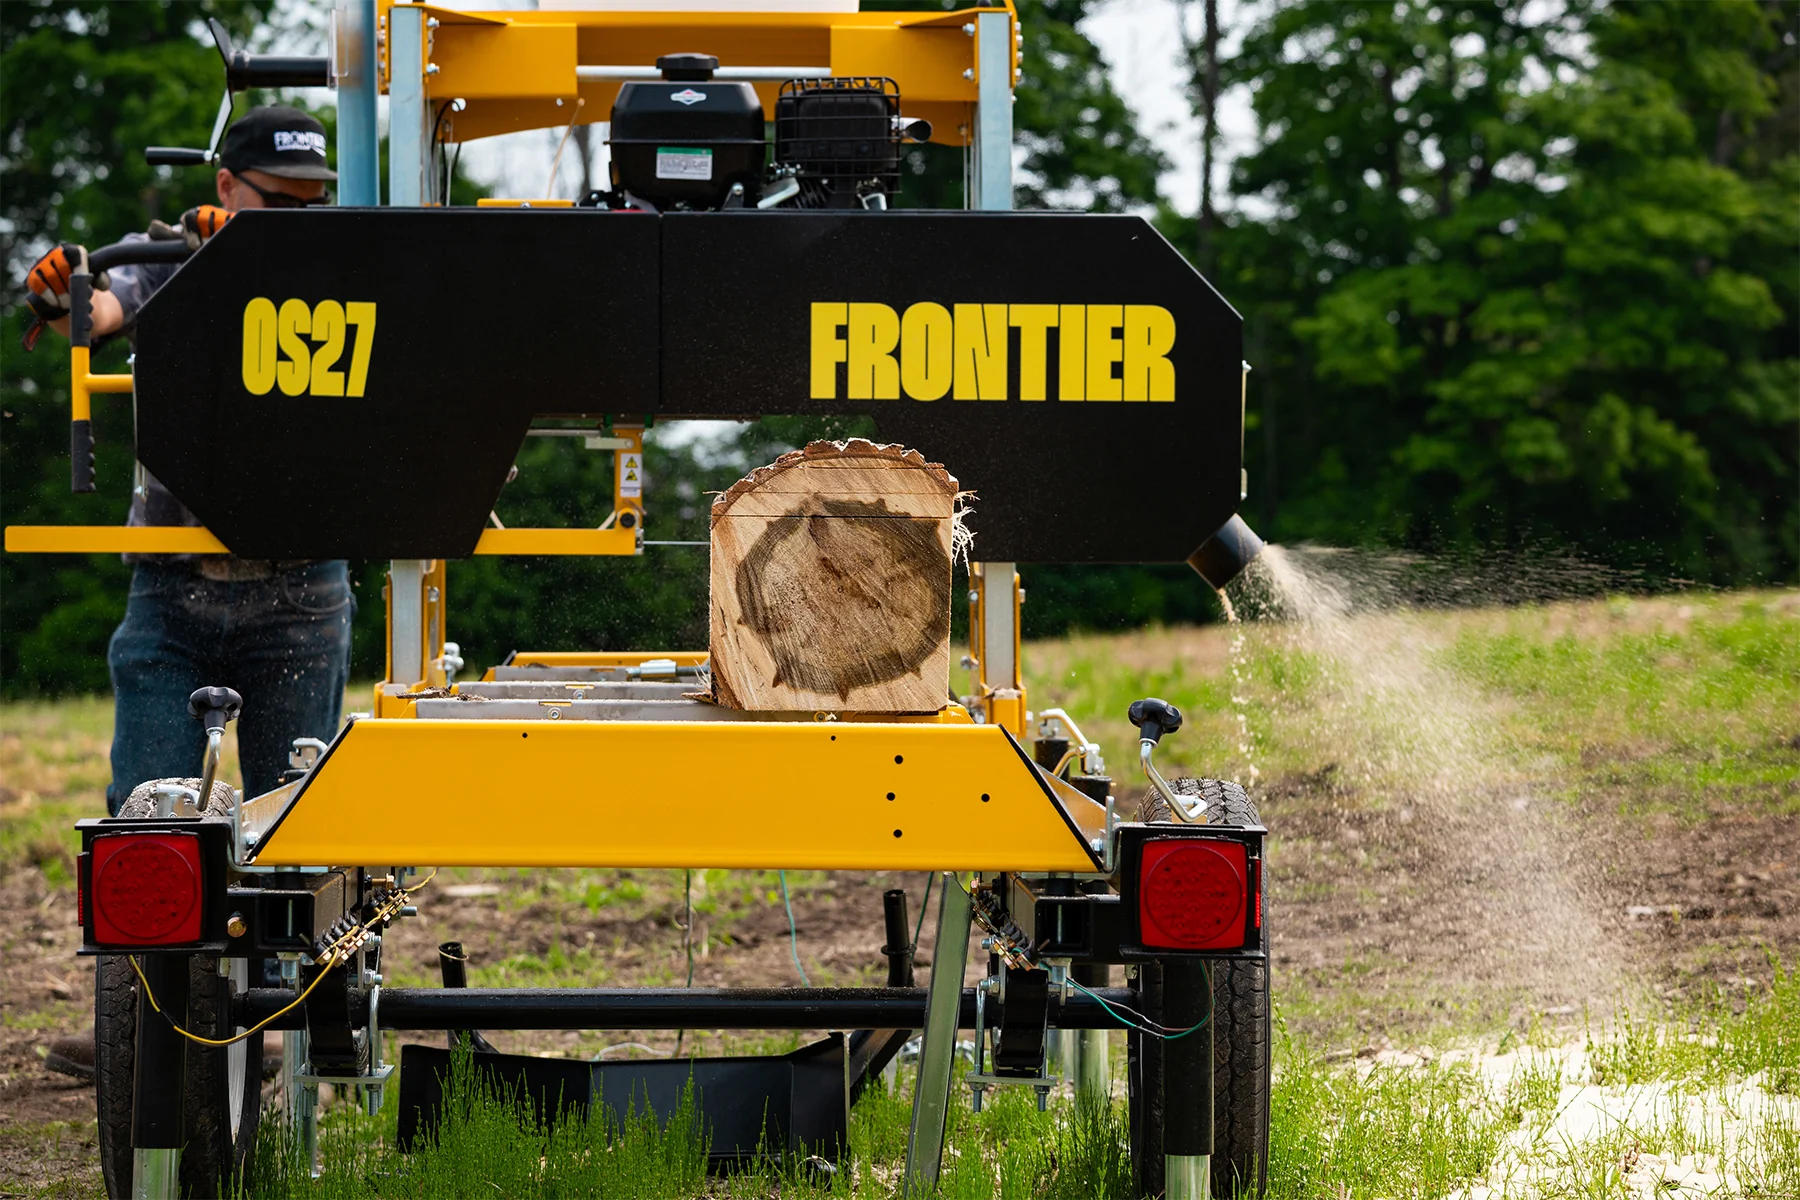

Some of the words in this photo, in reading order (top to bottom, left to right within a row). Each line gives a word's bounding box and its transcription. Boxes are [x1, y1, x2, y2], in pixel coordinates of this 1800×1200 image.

[274, 131, 326, 149] FRONTI
[242, 297, 376, 397] OS27
[810, 302, 1176, 402] FRONTIER
